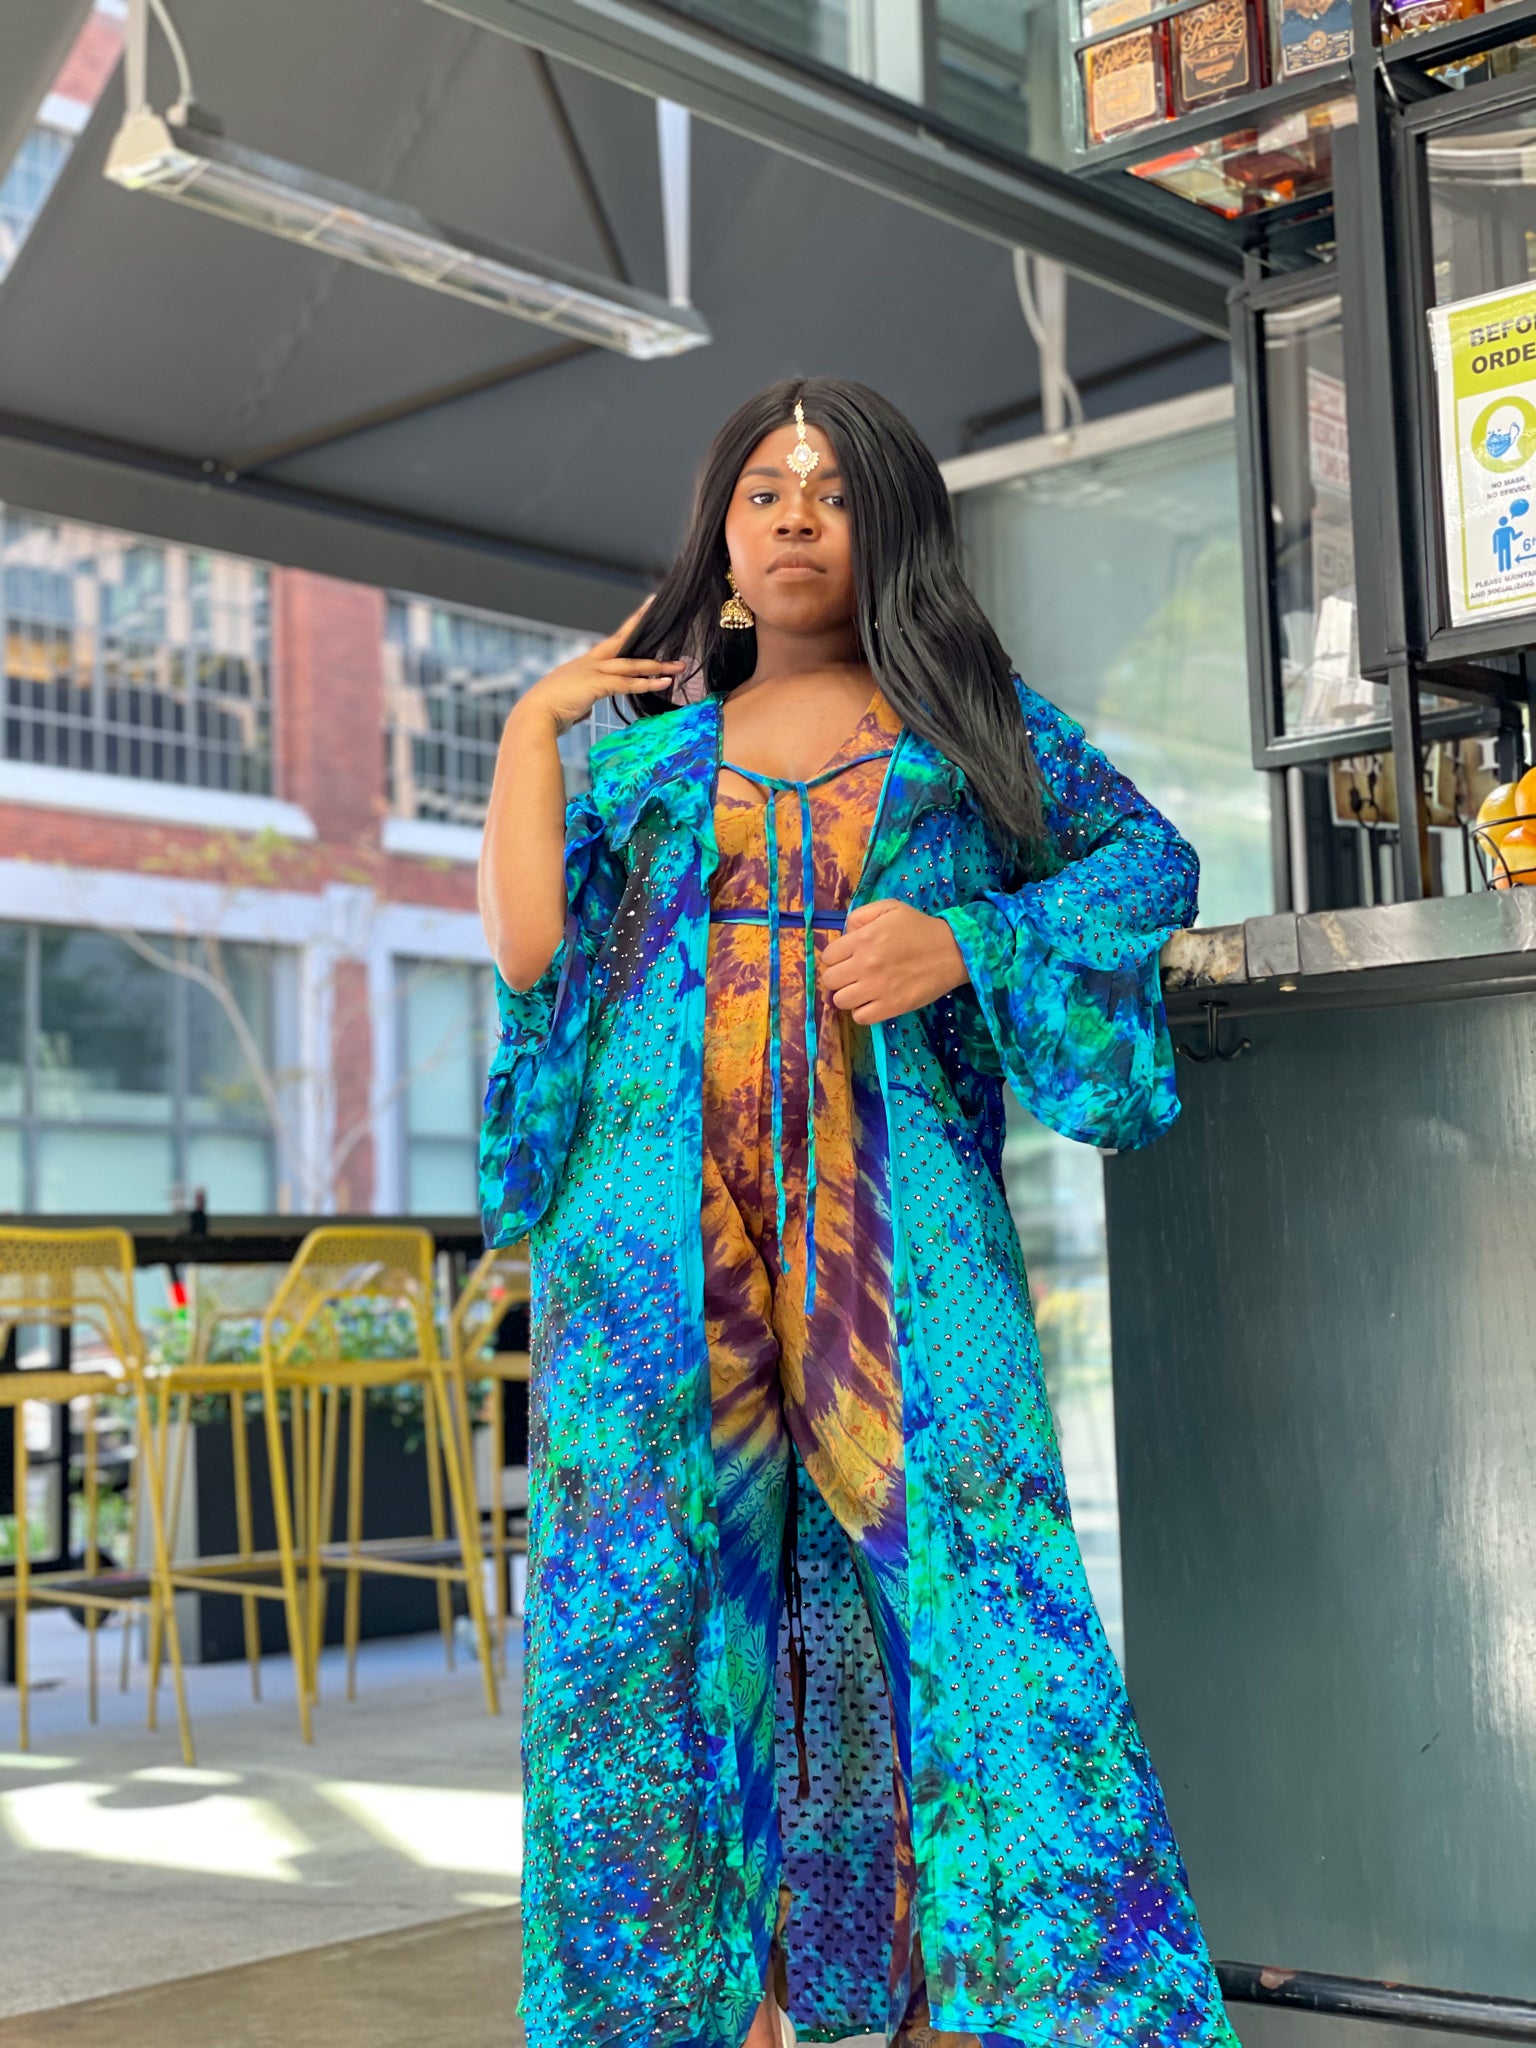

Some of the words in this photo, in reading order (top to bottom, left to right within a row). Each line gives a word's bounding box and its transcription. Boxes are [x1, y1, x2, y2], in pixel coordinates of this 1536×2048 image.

[1470, 313, 1536, 347] BEFO
[1504, 475, 1525, 486] MASK
[1500, 484, 1531, 496] SERVICE
[1475, 577, 1502, 588] PLEASE
[1470, 590, 1486, 599] AND
